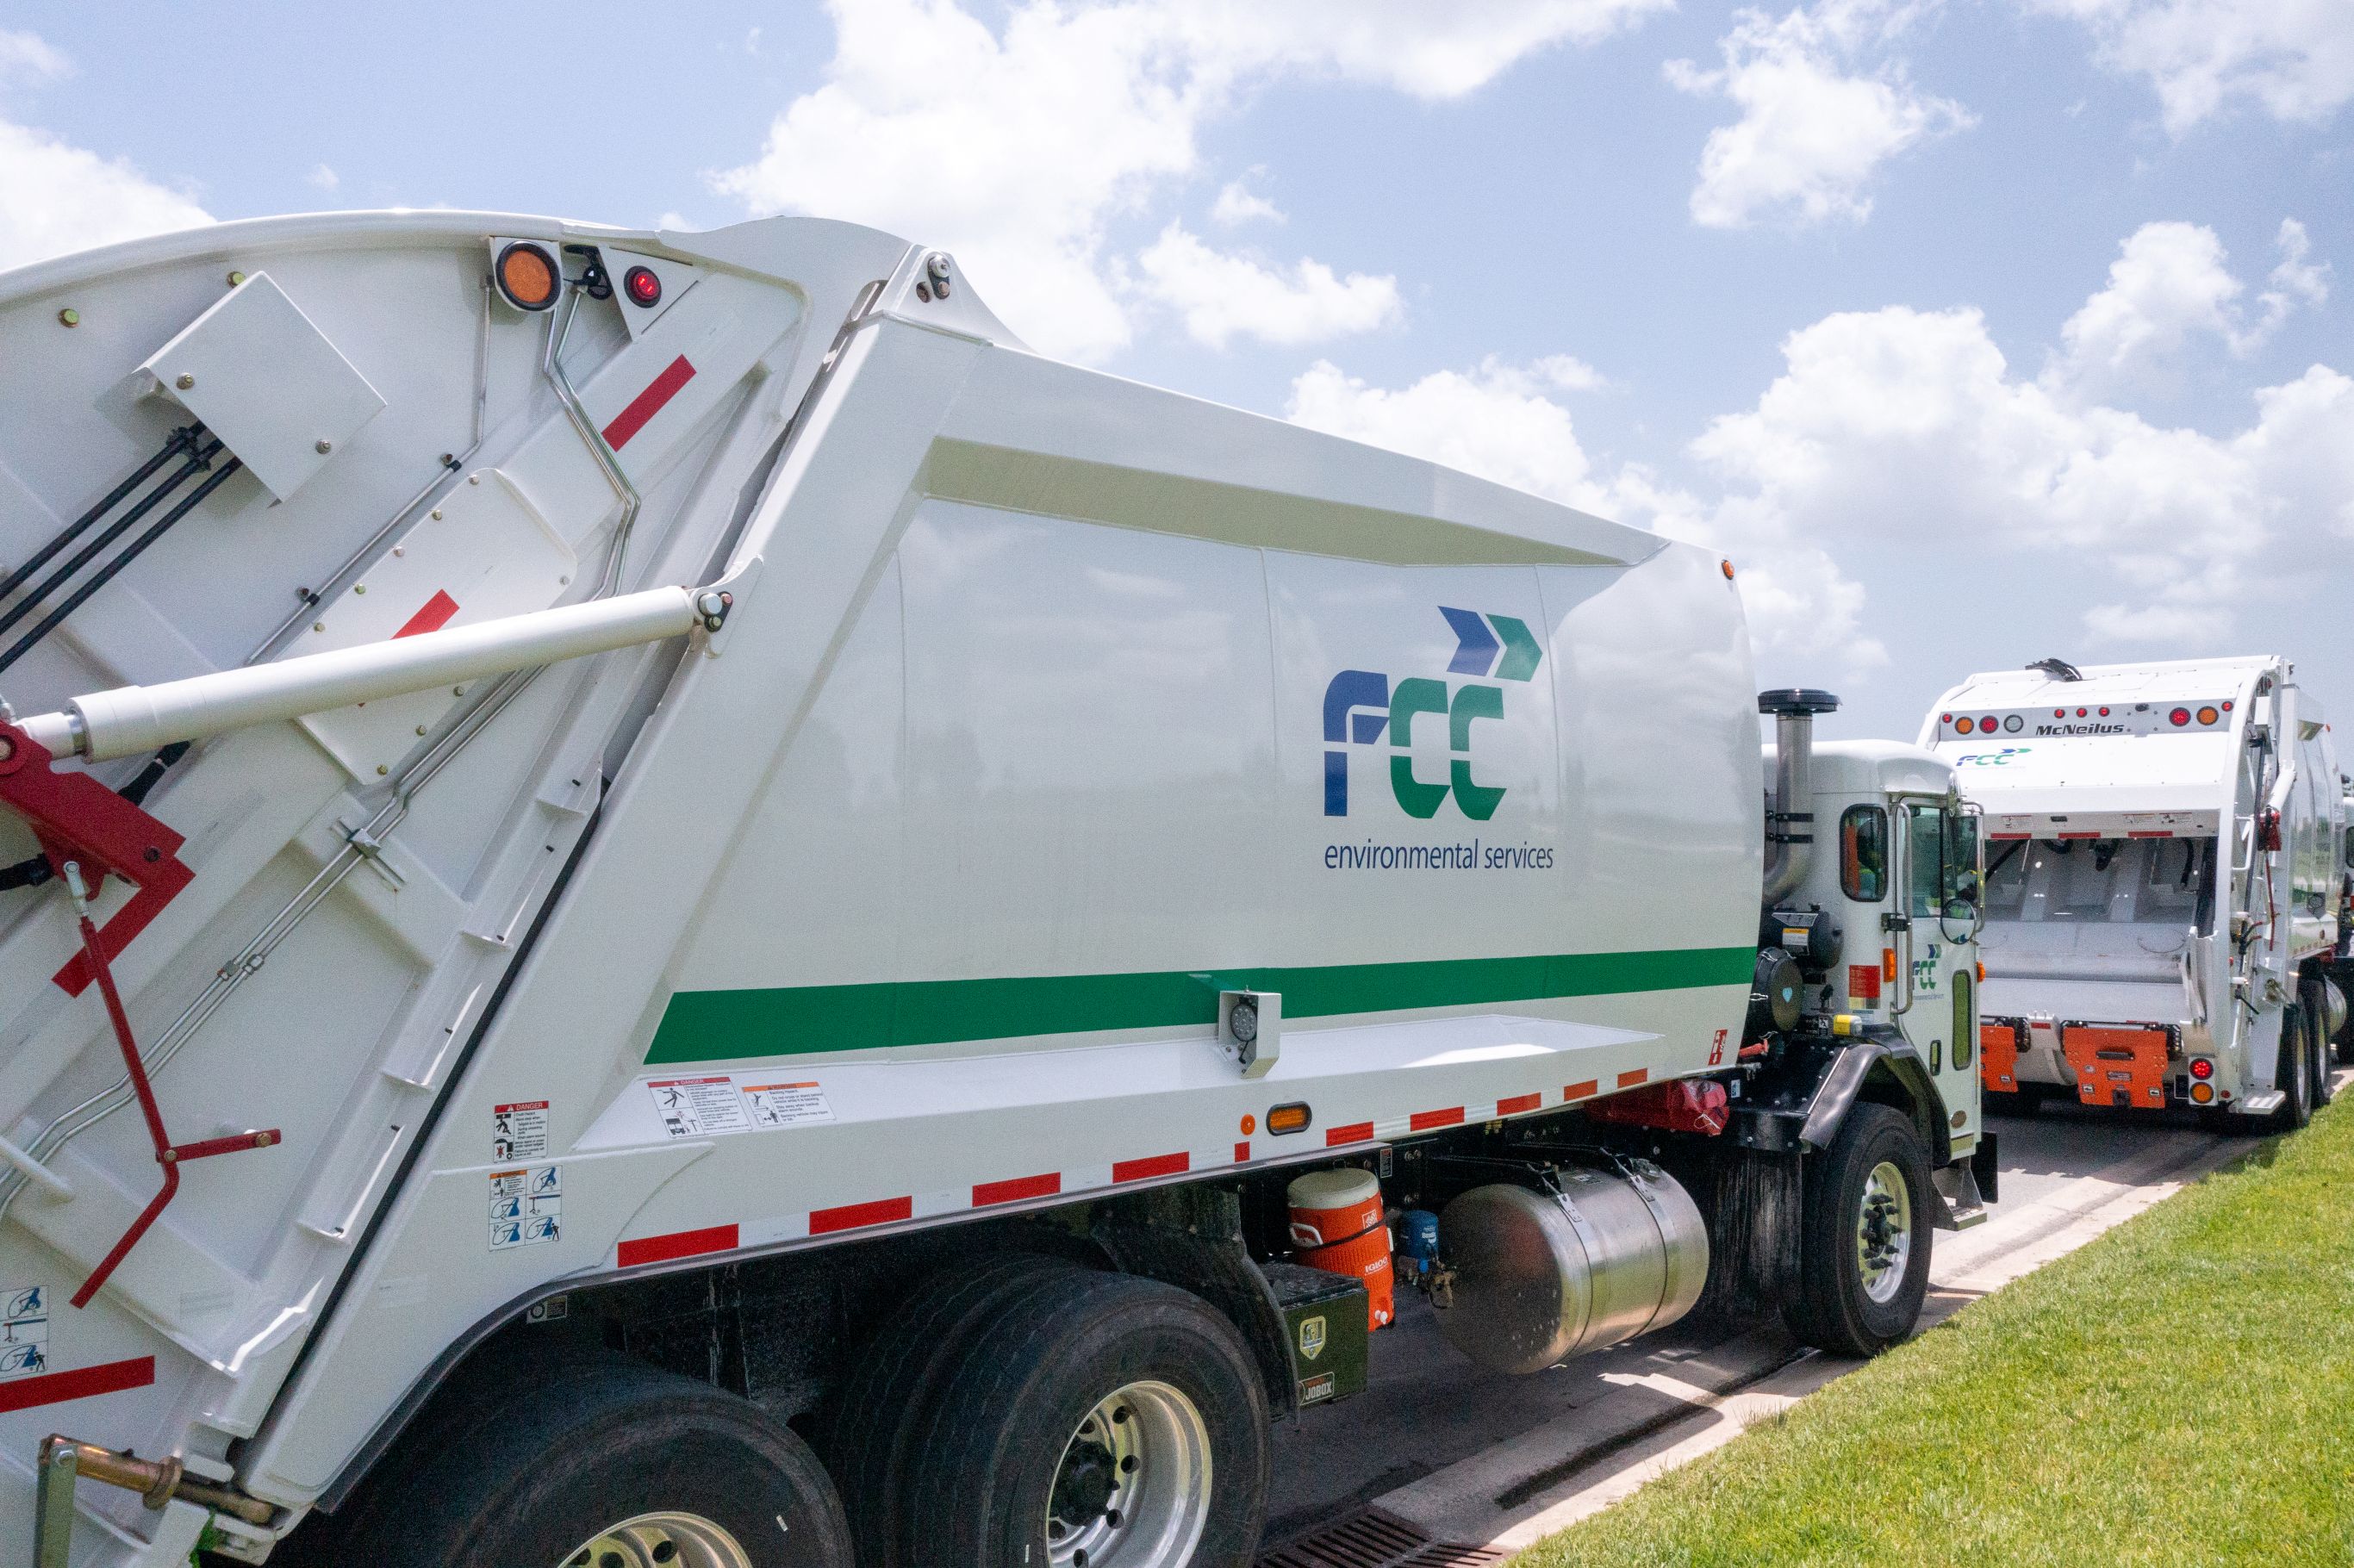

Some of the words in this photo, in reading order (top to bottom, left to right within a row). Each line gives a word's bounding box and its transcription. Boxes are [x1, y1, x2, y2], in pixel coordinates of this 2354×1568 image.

[2035, 724, 2124, 736] McNeilus
[1323, 669, 1507, 821] FCC
[1956, 754, 2015, 767] FCC
[1324, 838, 1478, 869] environmental
[1485, 842, 1554, 869] services
[1912, 960, 1936, 991] FCC
[516, 1102, 543, 1111] DANGER
[1365, 1256, 1388, 1272] IGLOO
[1305, 1381, 1332, 1401] JOBOX
